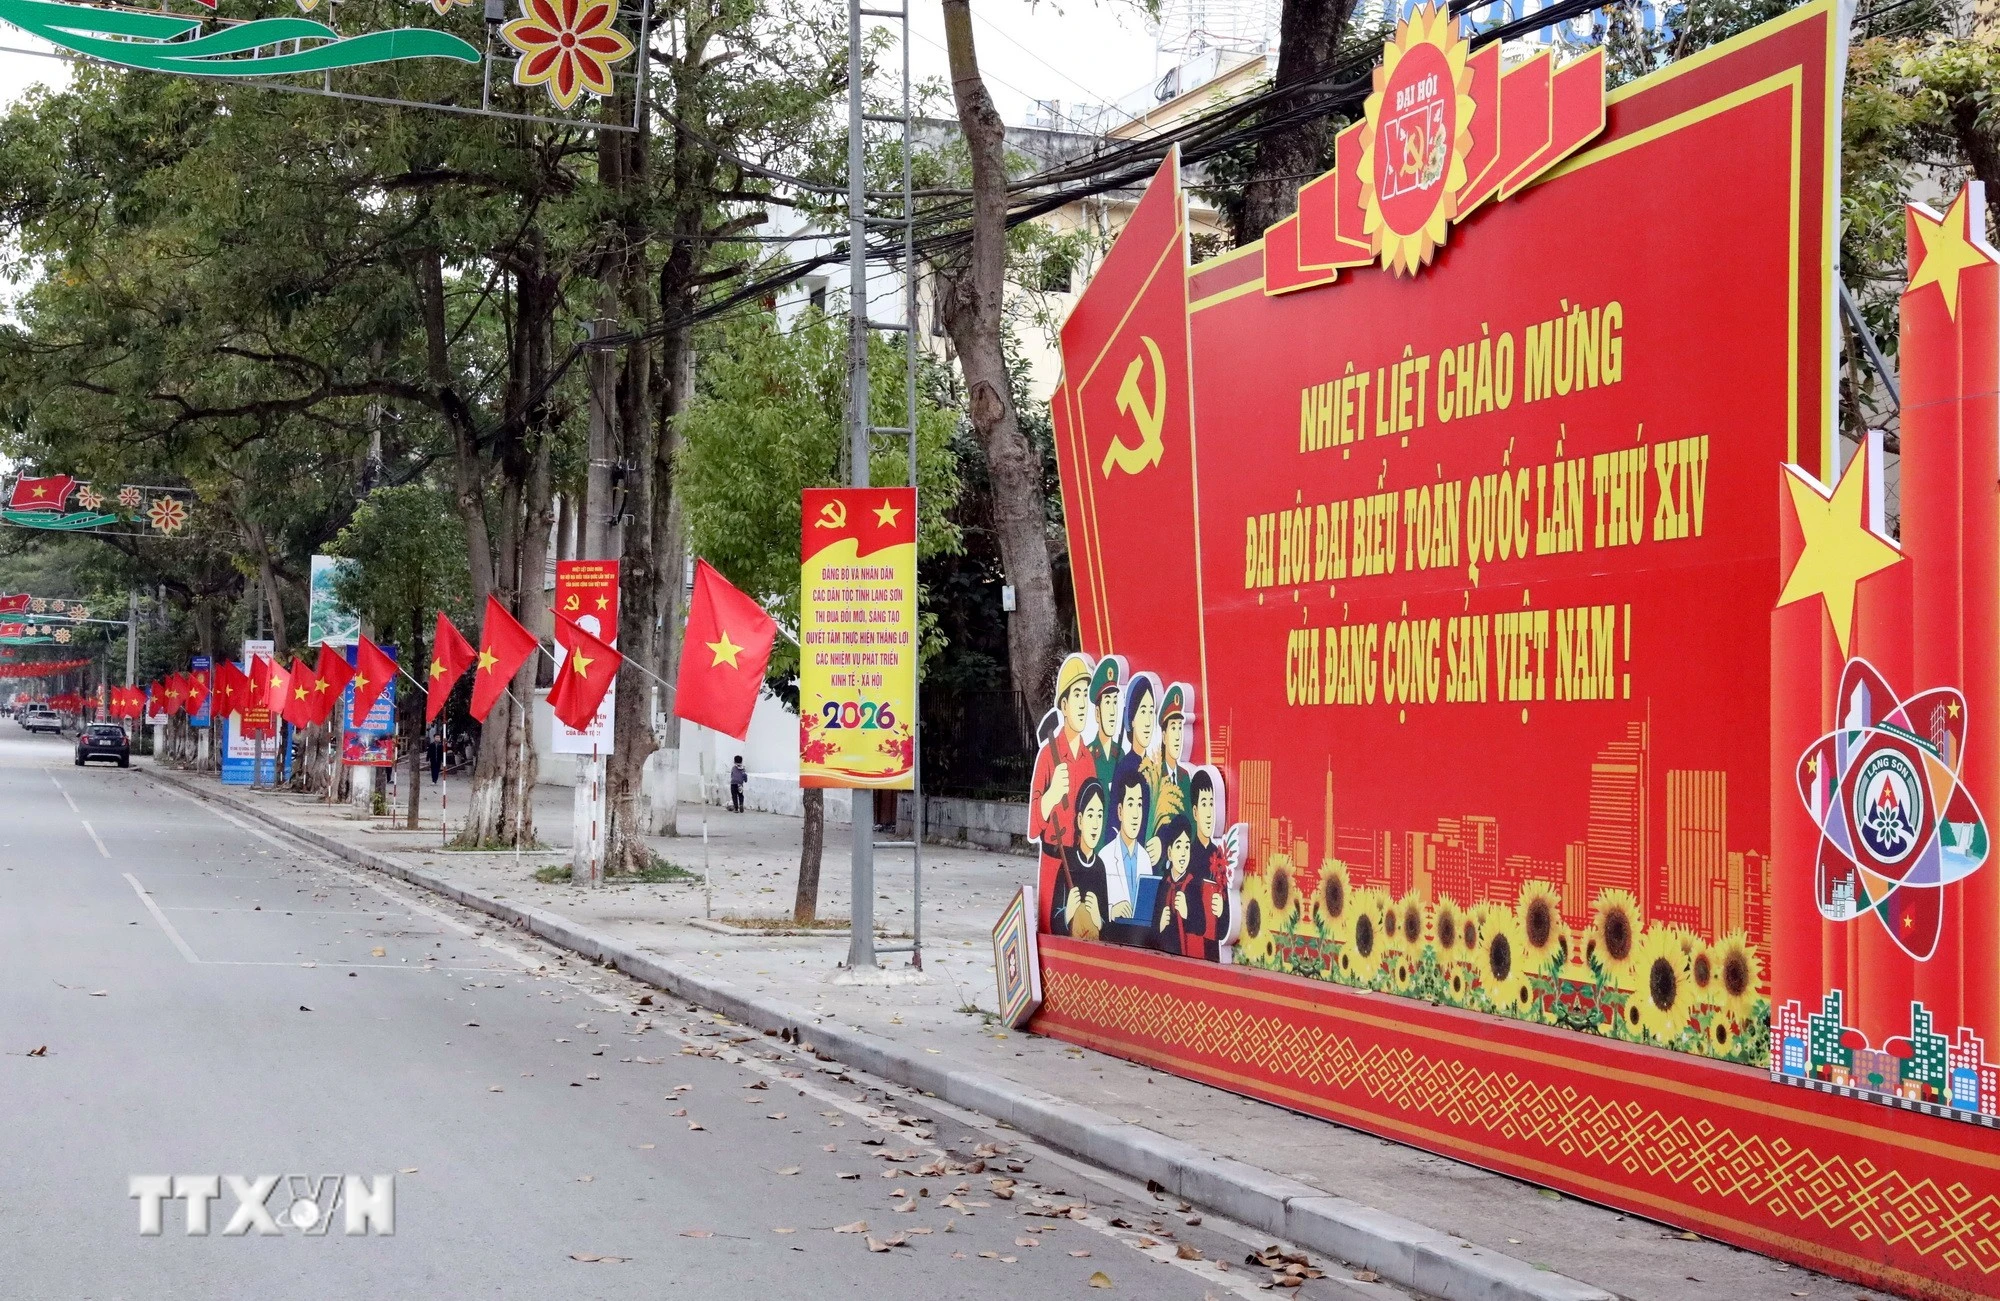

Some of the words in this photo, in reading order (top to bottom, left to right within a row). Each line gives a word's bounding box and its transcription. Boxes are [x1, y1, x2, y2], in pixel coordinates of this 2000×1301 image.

[1396, 84, 1415, 112] ĐẠI
[1417, 72, 1438, 102] HỘI
[1299, 361, 1370, 460] NHIỆT
[1375, 345, 1430, 448] LIỆT
[1437, 322, 1515, 423] CHÀO
[1524, 298, 1623, 403] MỪNG
[1245, 513, 1276, 605] ĐẠI
[1278, 489, 1312, 602] HỘI
[1315, 499, 1349, 598] ĐẠI
[1352, 458, 1399, 577] BIỂU
[1404, 464, 1462, 571] TOÀN
[1467, 436, 1529, 588] QUỐC
[1536, 423, 1586, 556] LẦN
[1592, 423, 1648, 549] THỨ
[1653, 434, 1709, 541] XIV
[822, 565, 839, 580] ĐẢNG
[841, 566, 849, 583] BỘ
[861, 566, 879, 580] NHÂN
[881, 566, 893, 580] DÂN
[813, 587, 825, 601] CÁC
[827, 587, 840, 601] DÂN
[842, 587, 853, 604] TỘC
[872, 589, 887, 604] LẠNG
[890, 589, 902, 601] SƠN
[815, 611, 825, 622] THI
[827, 611, 839, 622] ĐUA
[869, 608, 886, 622] SÁNG
[888, 611, 899, 625] TẠO
[806, 628, 825, 644] QUYẾT
[827, 630, 840, 643] TÂM
[842, 632, 858, 646] THỰC
[860, 630, 875, 646] HIỆN
[899, 631, 908, 646] LỢI
[816, 651, 828, 665] CÁC
[830, 651, 850, 668] NHIỆM
[853, 653, 861, 668] VỤ
[862, 651, 878, 665] PHÁT
[1286, 605, 1320, 706] CỦA
[1325, 602, 1378, 705] ĐẢNG
[1382, 600, 1441, 724] CỘNG
[1446, 591, 1489, 703] SẢN
[1494, 589, 1549, 724] VIỆT
[1555, 604, 1615, 700] NAM
[831, 675, 846, 686] KINH
[848, 672, 855, 686] TẾ
[872, 672, 882, 689] HỘI
[822, 701, 896, 730] 2026
[1867, 757, 1889, 777] LẠNG
[1891, 759, 1909, 778] SƠN
